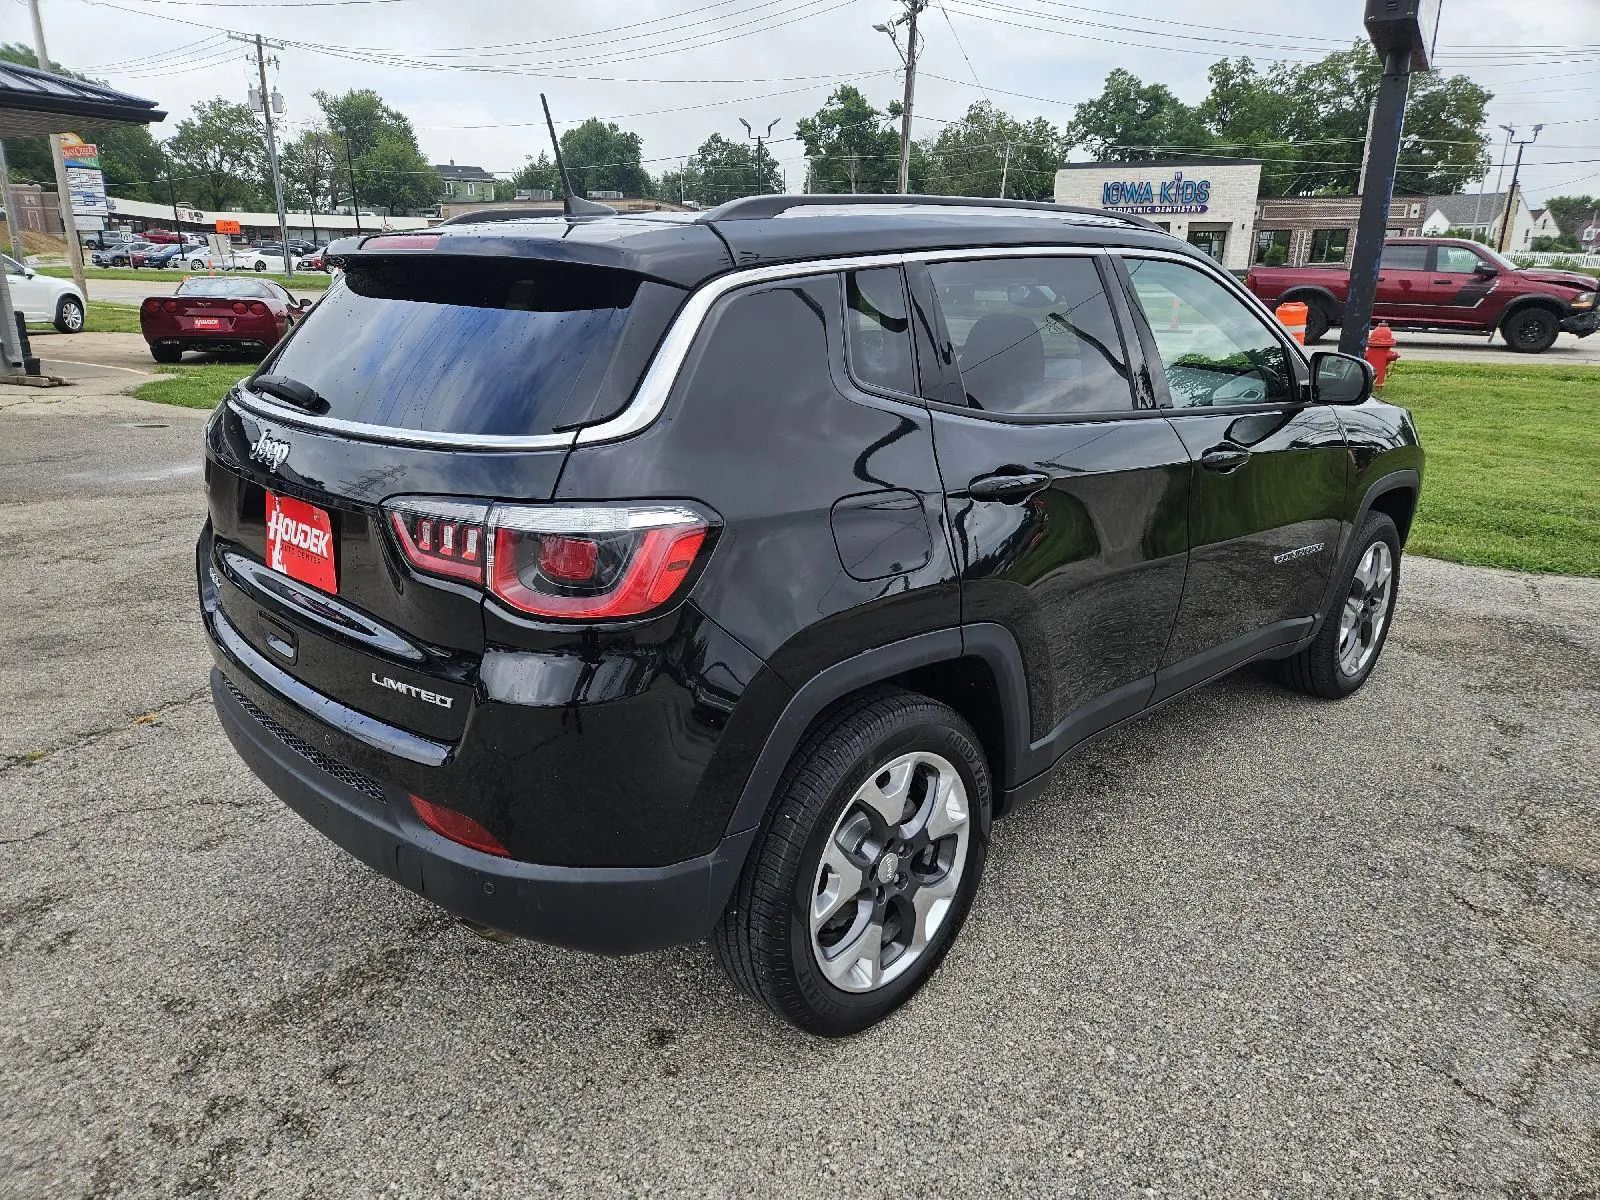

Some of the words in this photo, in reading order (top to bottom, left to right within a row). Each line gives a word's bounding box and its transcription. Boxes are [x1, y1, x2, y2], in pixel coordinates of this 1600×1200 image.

[1102, 181, 1153, 204] IOWA
[1160, 171, 1211, 204] KIDS
[1154, 205, 1202, 213] DENTISTRY
[249, 429, 291, 473] Jeep
[268, 510, 330, 558] HOUDEK
[297, 550, 321, 565] CENTER
[371, 672, 454, 709] LIMITED
